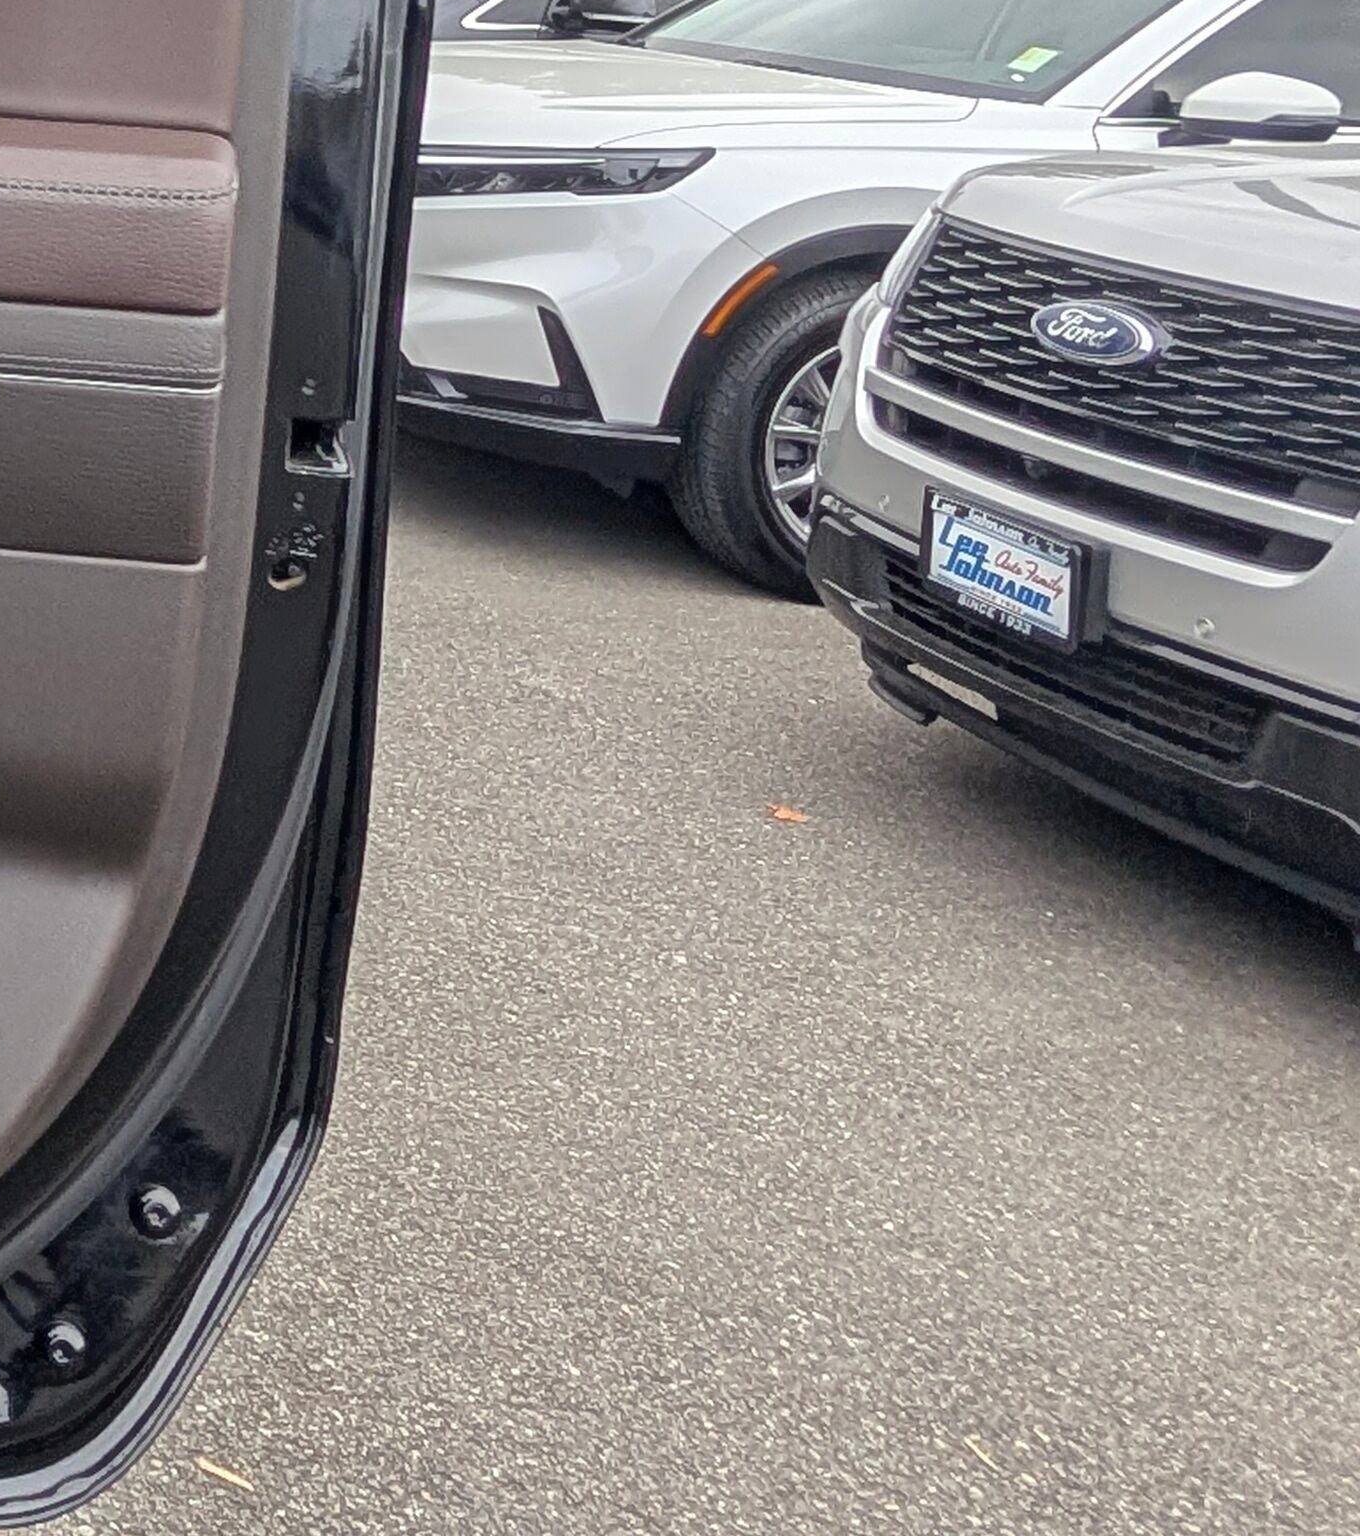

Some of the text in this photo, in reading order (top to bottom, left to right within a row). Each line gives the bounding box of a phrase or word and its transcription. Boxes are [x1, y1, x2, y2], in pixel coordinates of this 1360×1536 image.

[1047, 308, 1118, 348] Ford
[938, 515, 991, 561] Lee
[938, 546, 1053, 616] Johnson
[1025, 559, 1065, 600] Family
